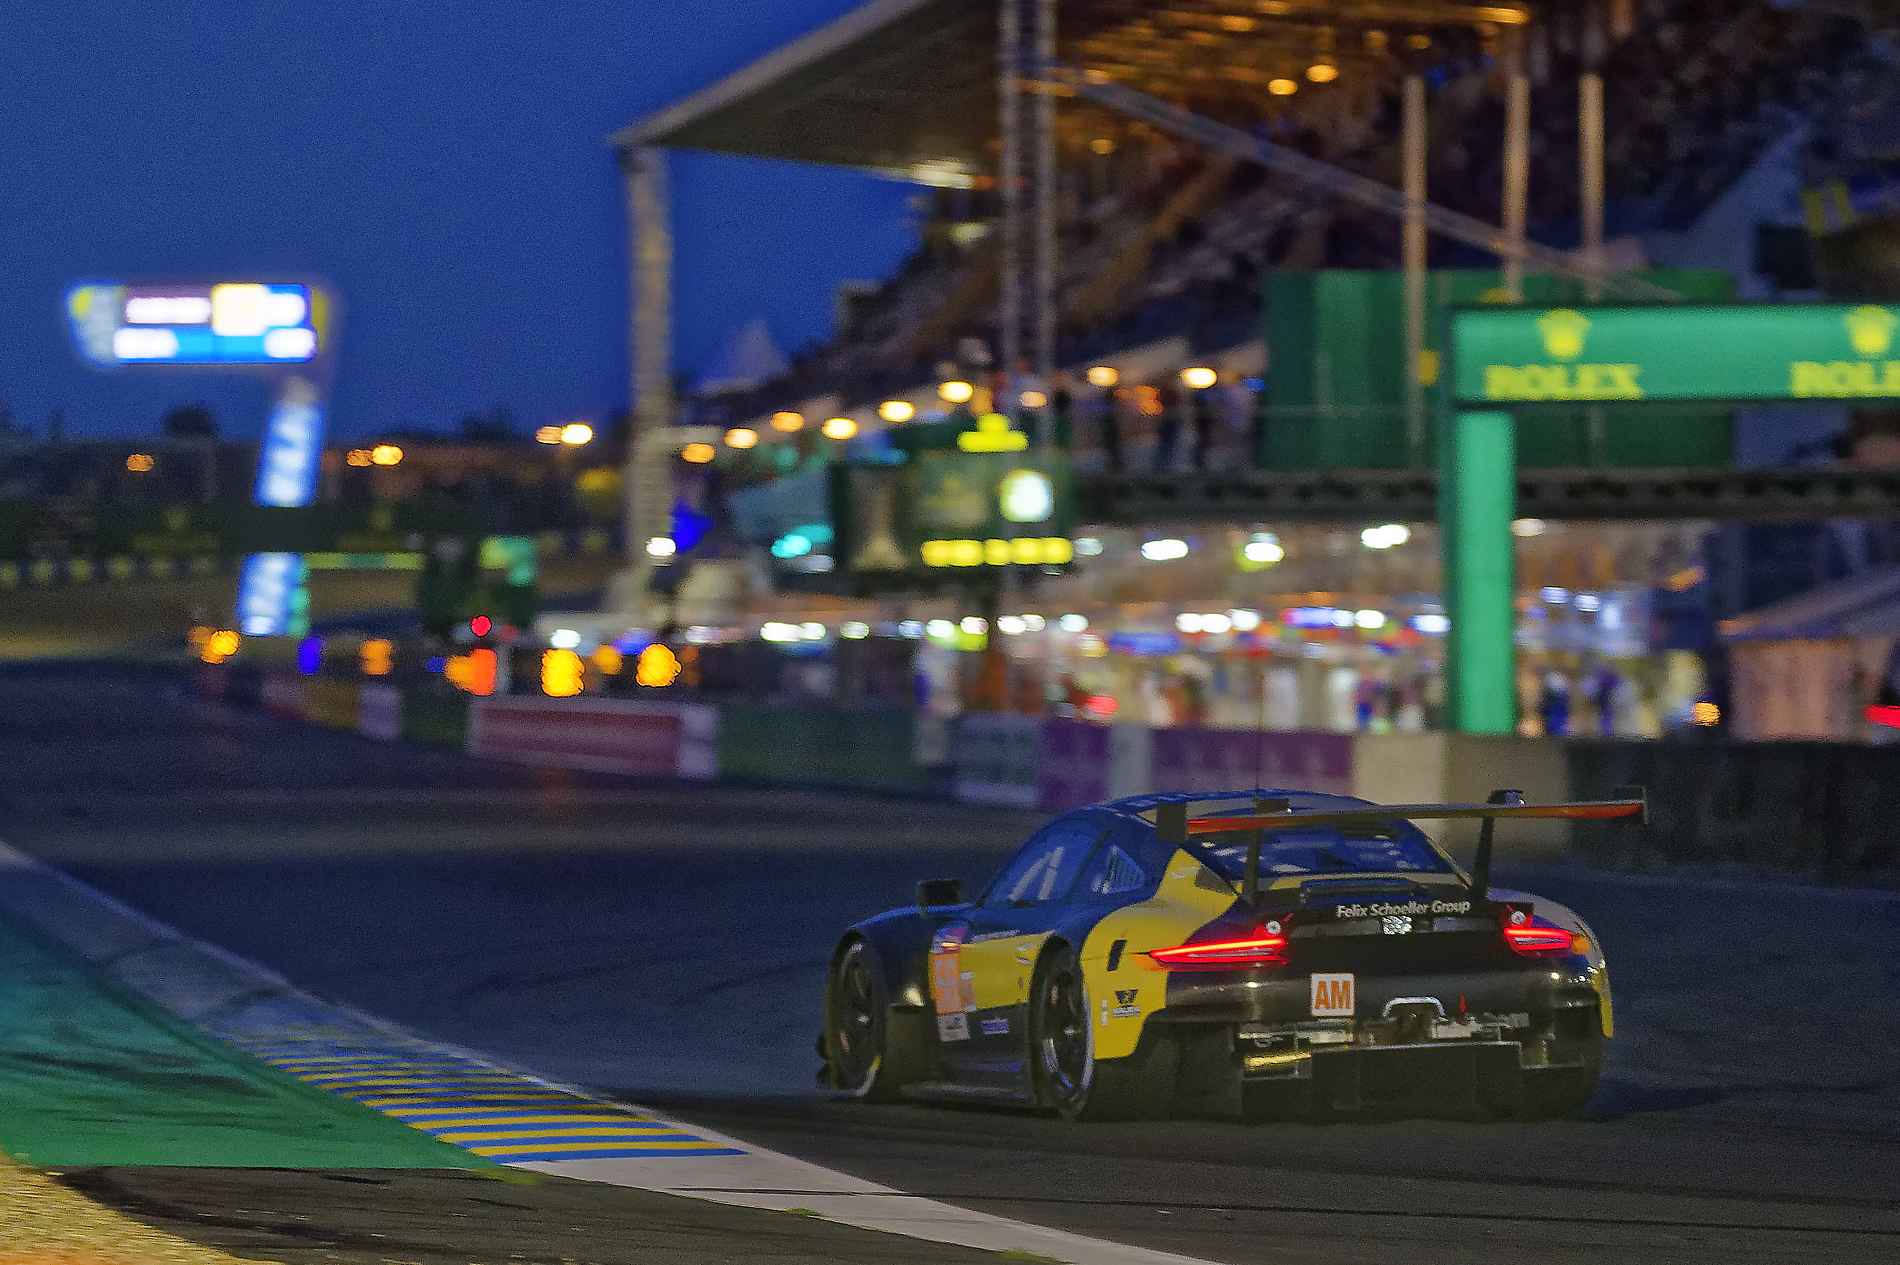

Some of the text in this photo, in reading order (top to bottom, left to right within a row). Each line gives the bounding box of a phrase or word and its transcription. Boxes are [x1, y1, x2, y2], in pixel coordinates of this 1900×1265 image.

[1486, 363, 1644, 401] ROLEX
[1336, 899, 1472, 918] Felix Schoeller Group
[1314, 980, 1351, 1010] AM
